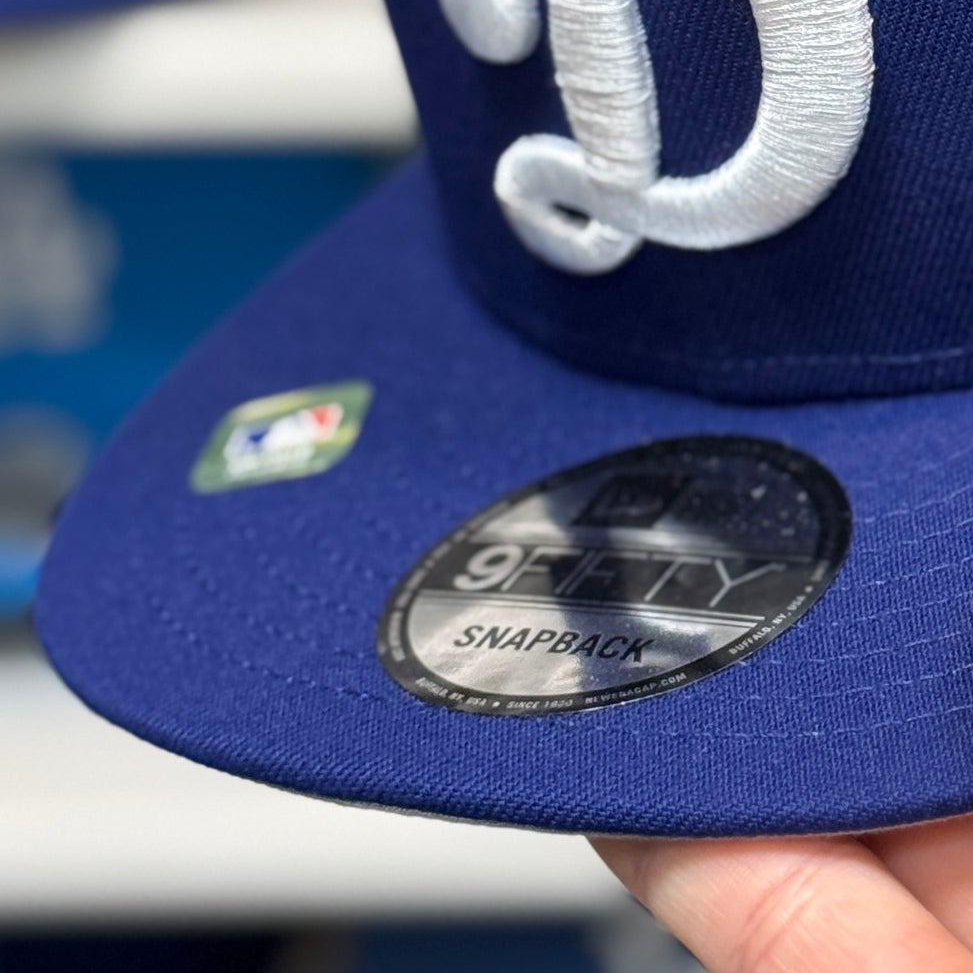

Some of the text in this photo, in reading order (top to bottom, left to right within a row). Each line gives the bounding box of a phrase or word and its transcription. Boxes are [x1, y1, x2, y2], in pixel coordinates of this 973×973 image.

[453, 543, 787, 608] 9FIFTY
[453, 624, 656, 663] SNAPBACK
[505, 700, 541, 710] SINCE
